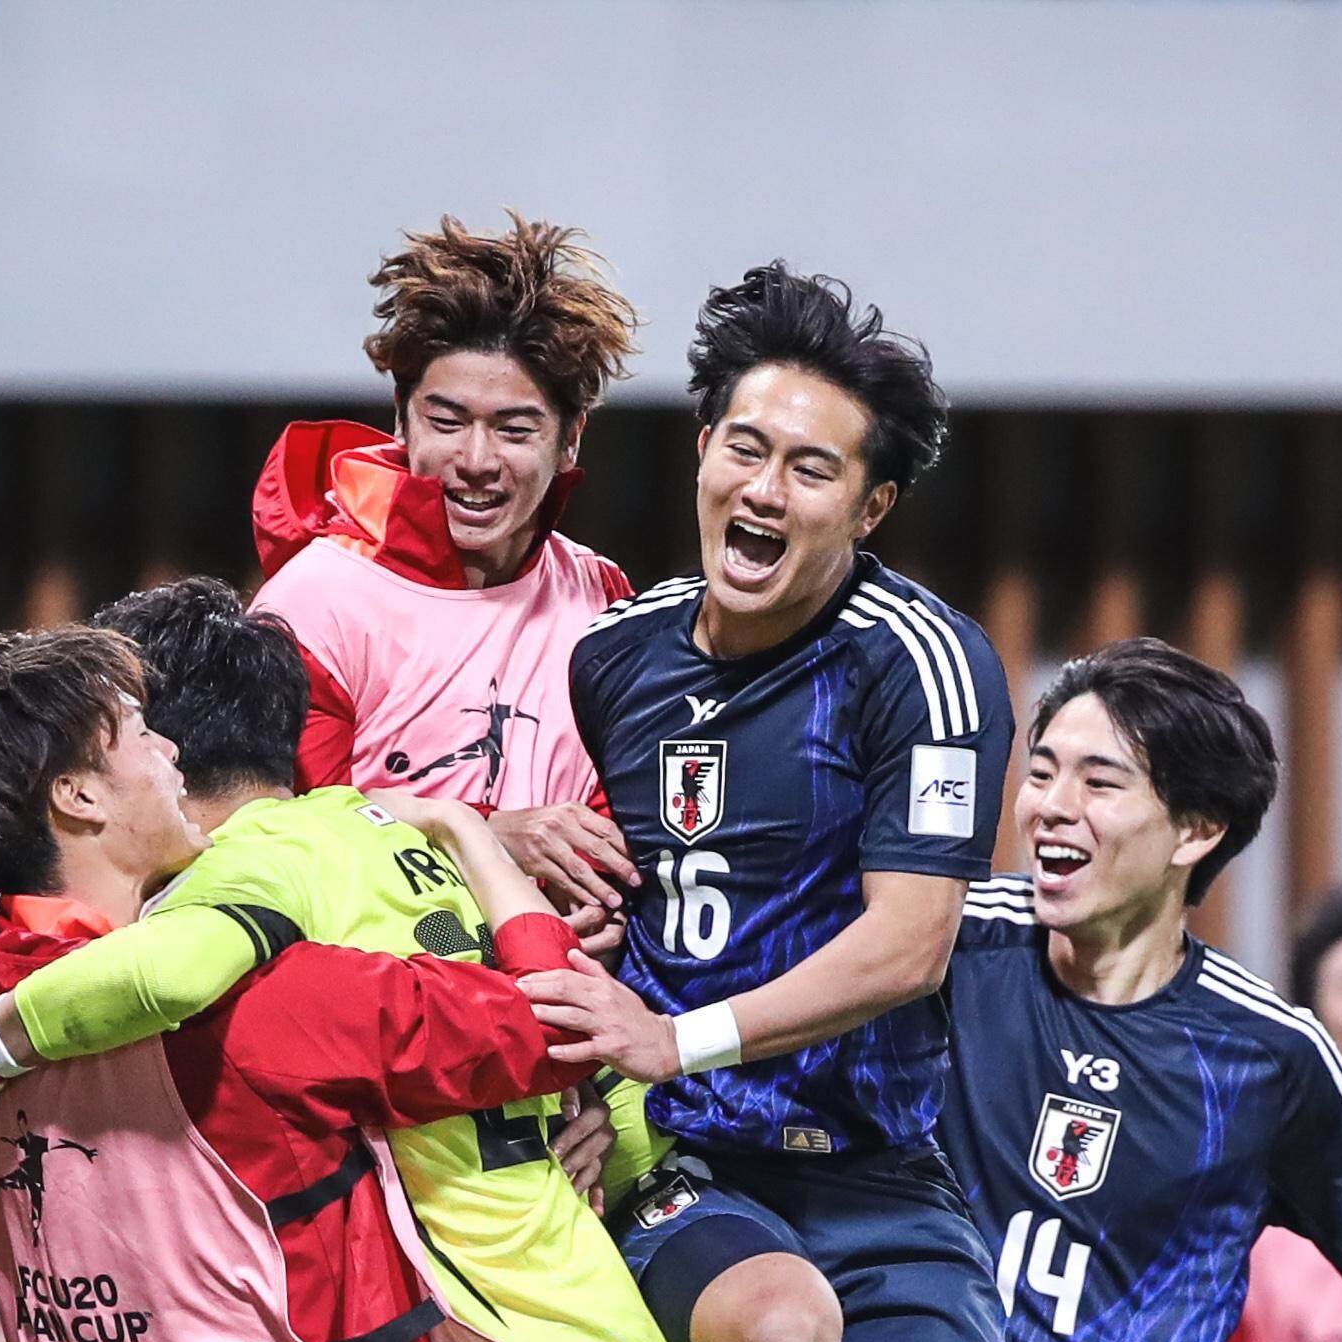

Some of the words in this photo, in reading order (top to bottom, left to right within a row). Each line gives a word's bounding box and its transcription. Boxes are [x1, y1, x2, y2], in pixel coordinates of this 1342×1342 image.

[675, 744, 710, 755] JAPAN
[918, 779, 970, 799] AFC
[393, 848, 466, 896] AR
[656, 849, 731, 960] 16
[1060, 1048, 1120, 1092] Y-3
[1062, 1102, 1102, 1119] JAPAN
[48, 1274, 118, 1310] U20
[996, 1210, 1092, 1336] 14
